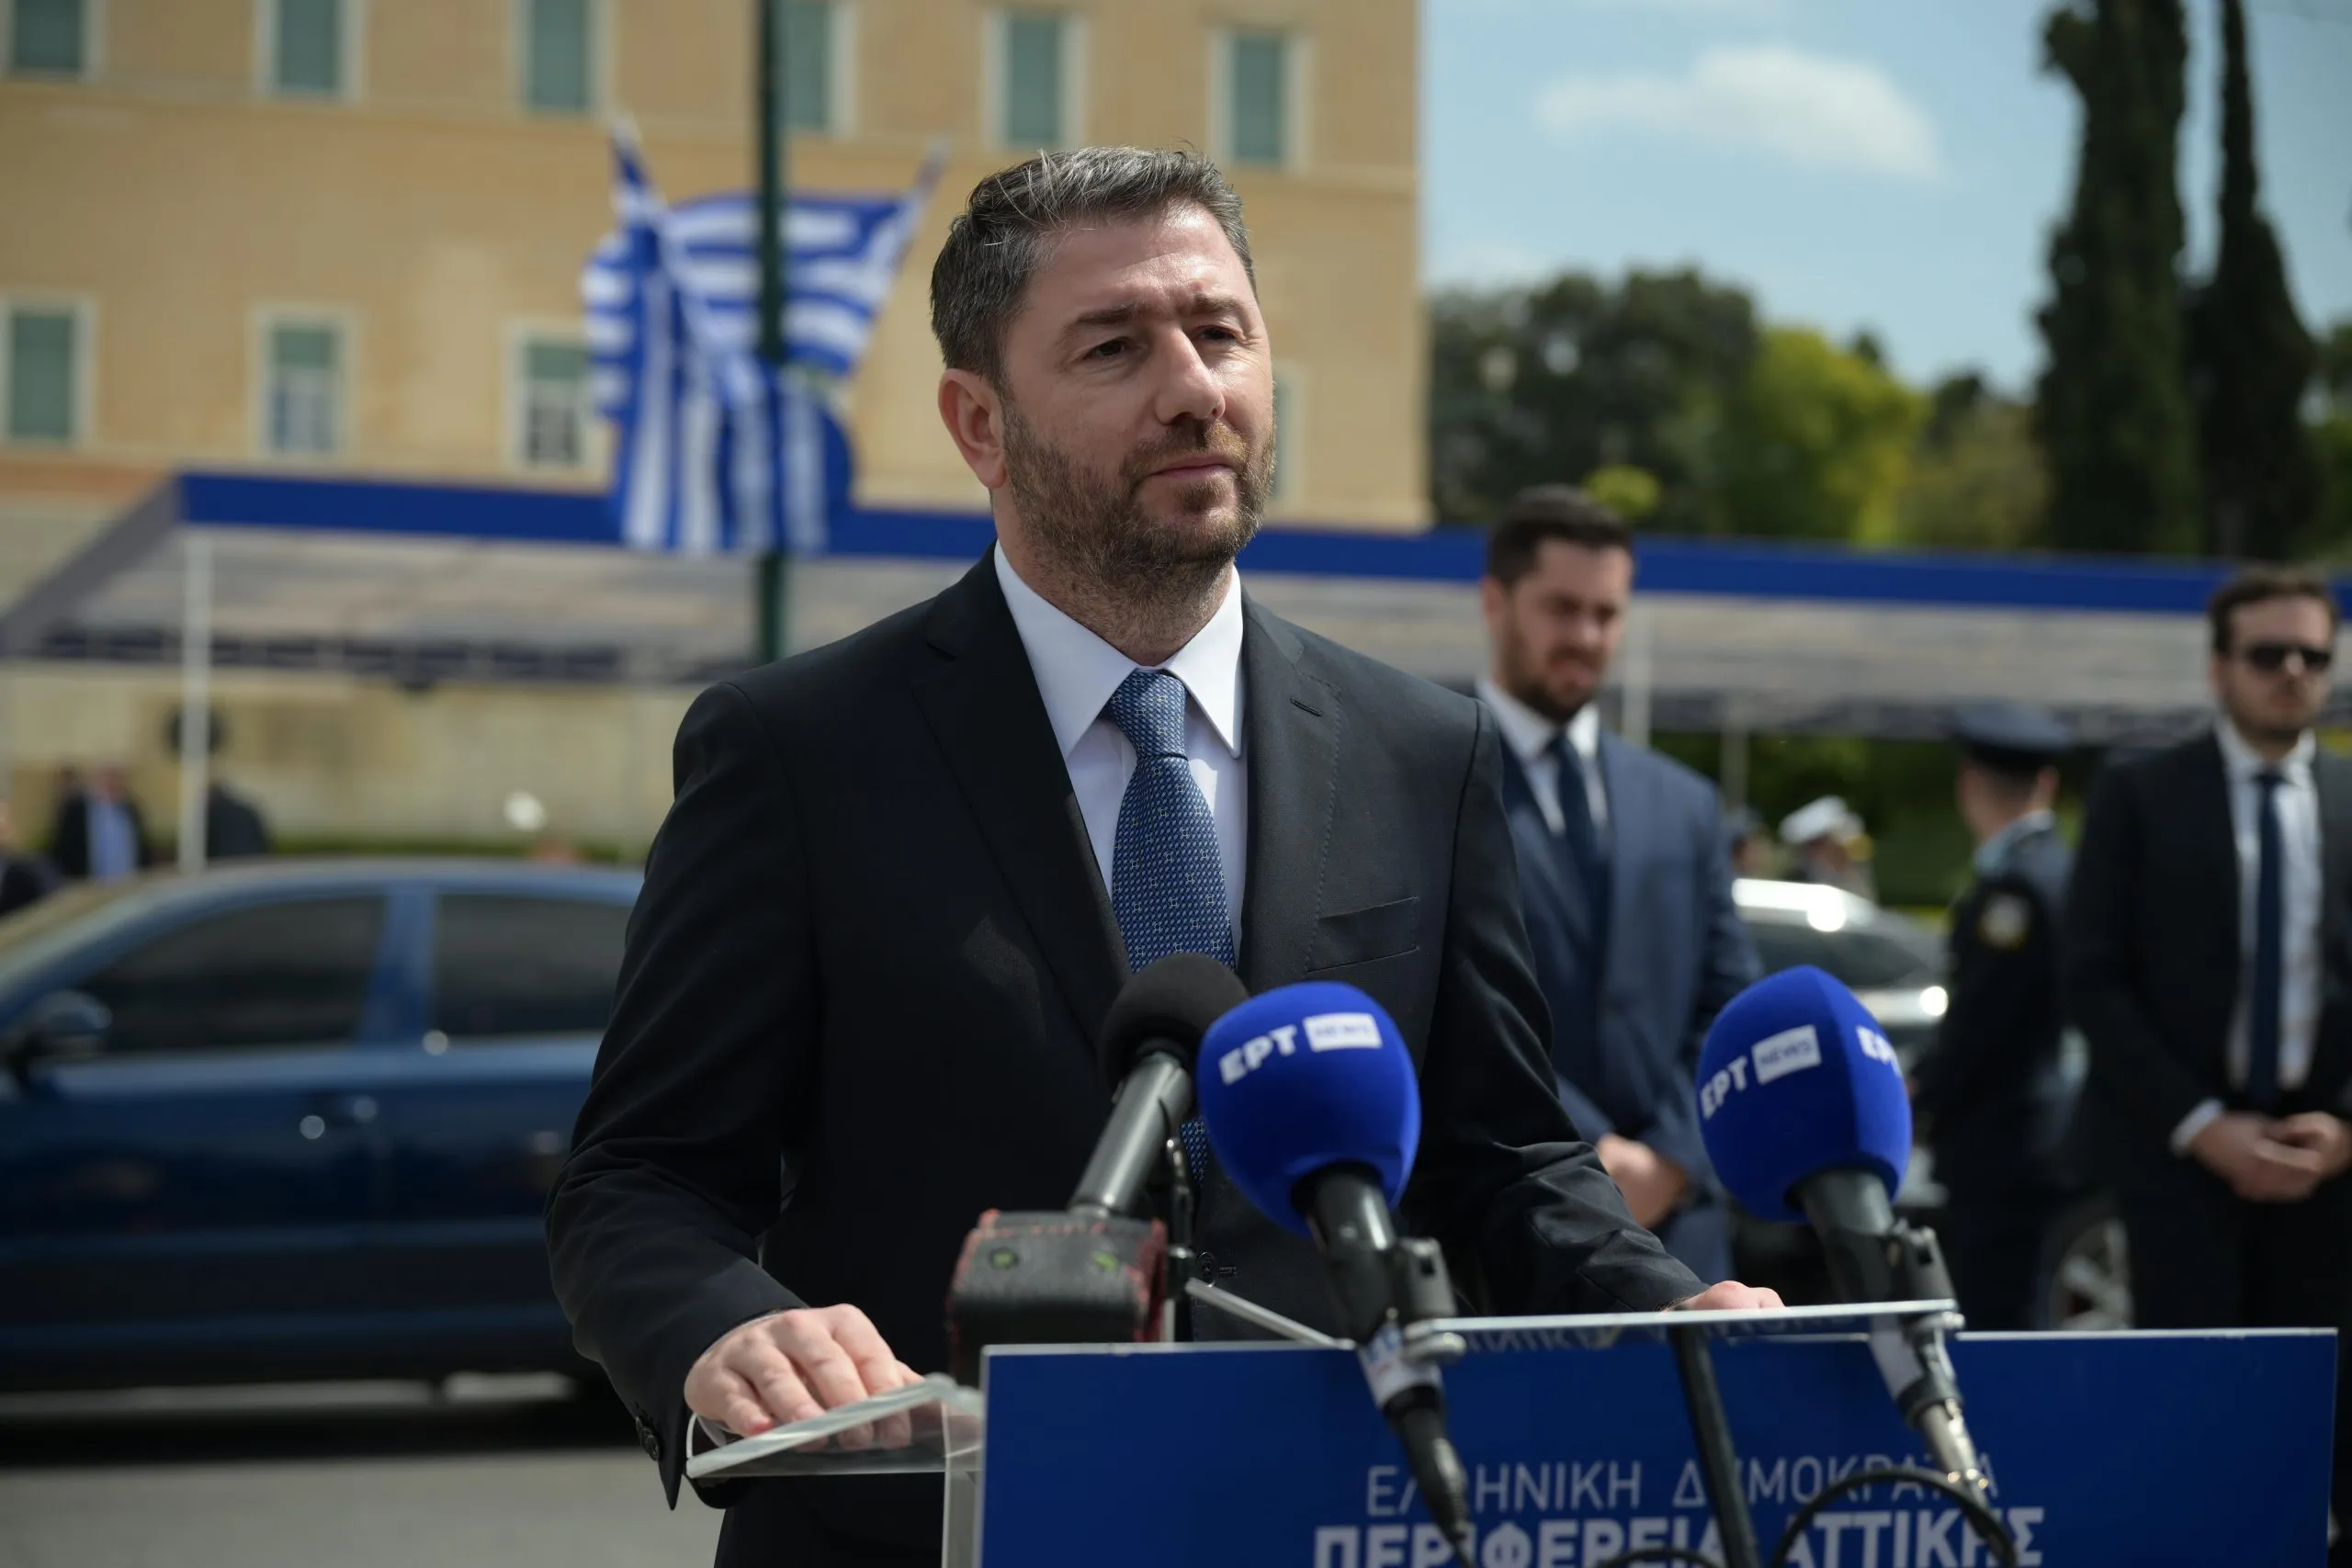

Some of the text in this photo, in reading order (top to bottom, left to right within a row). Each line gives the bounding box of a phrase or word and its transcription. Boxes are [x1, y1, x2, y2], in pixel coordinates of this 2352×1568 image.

[1218, 1023, 1297, 1086] ΕΡΤ
[1700, 1055, 1747, 1120] ΕΡΤ
[1365, 1451, 2000, 1516] ΕΗΝΙΚΗ ΔΜΟΚΡΑ
